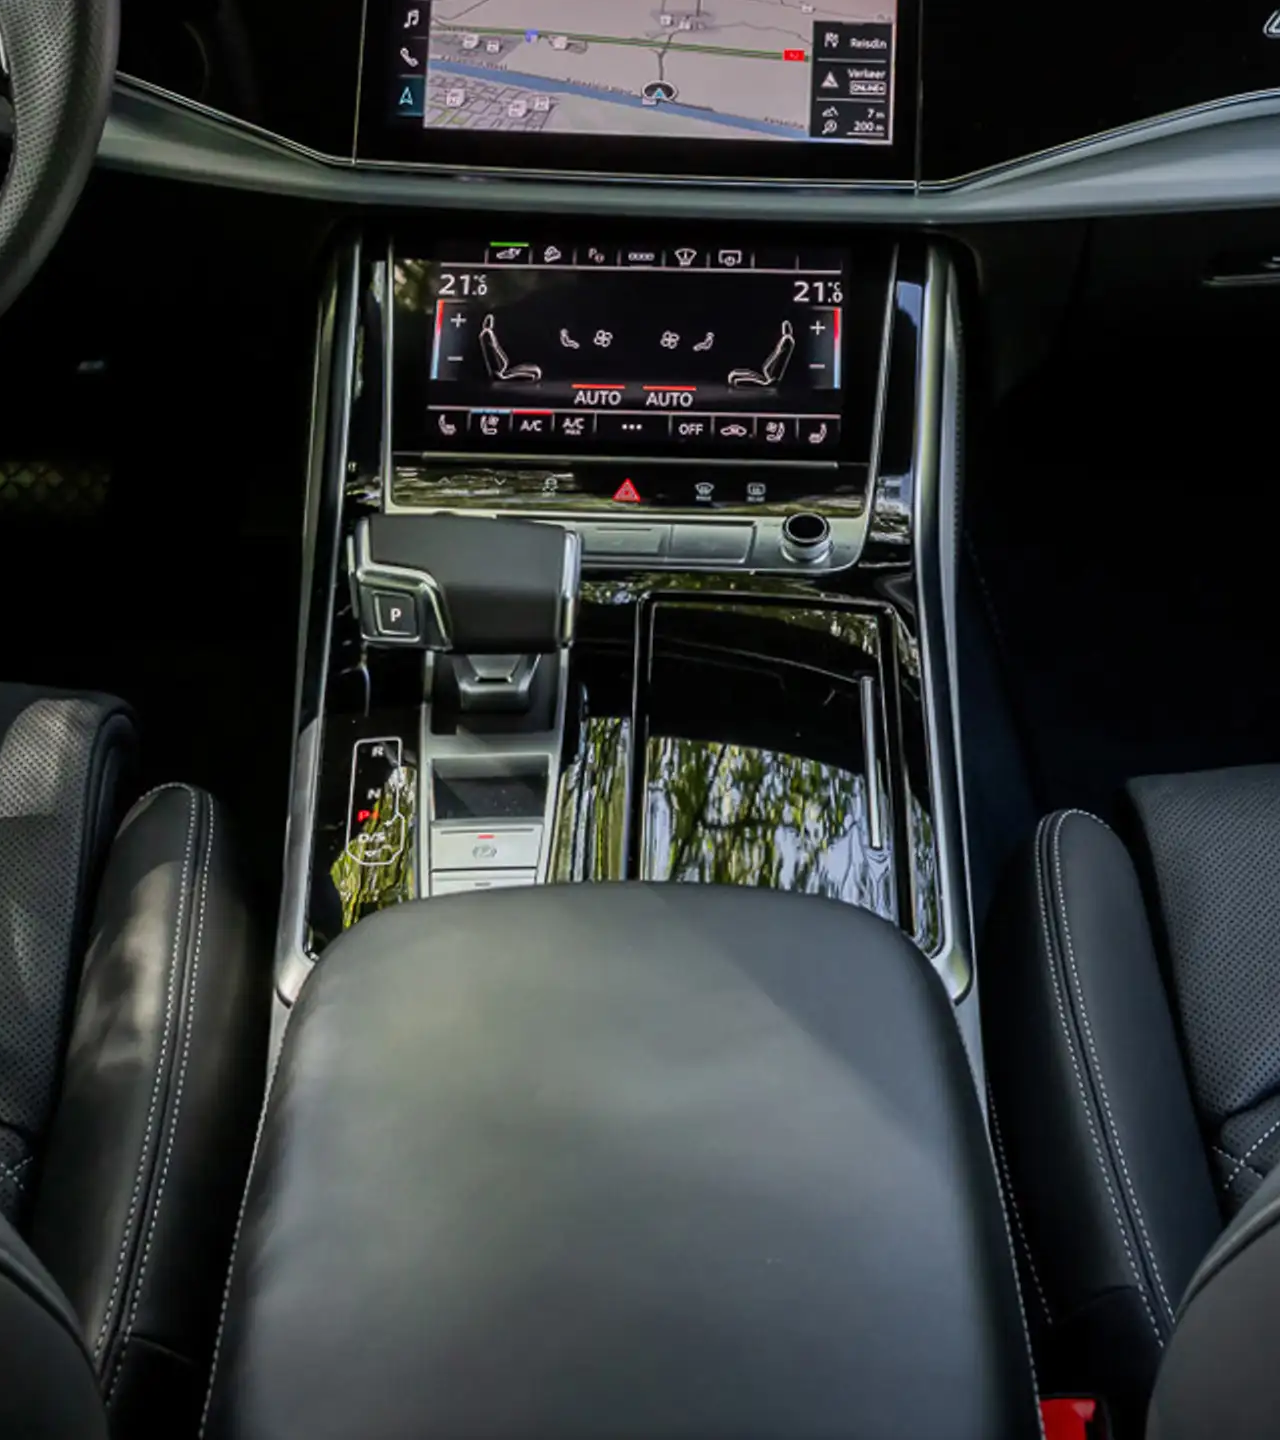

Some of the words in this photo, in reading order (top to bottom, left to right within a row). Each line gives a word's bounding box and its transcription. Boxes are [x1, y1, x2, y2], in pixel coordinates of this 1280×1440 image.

[854, 121, 873, 131] 200
[574, 391, 621, 405] AUTO
[646, 392, 694, 407] AUTO
[521, 421, 541, 432] A/C
[563, 418, 585, 428] A/C
[678, 424, 703, 435] OFF
[391, 608, 401, 621] P
[372, 746, 384, 757] R
[367, 789, 381, 799] N
[358, 810, 370, 822] P
